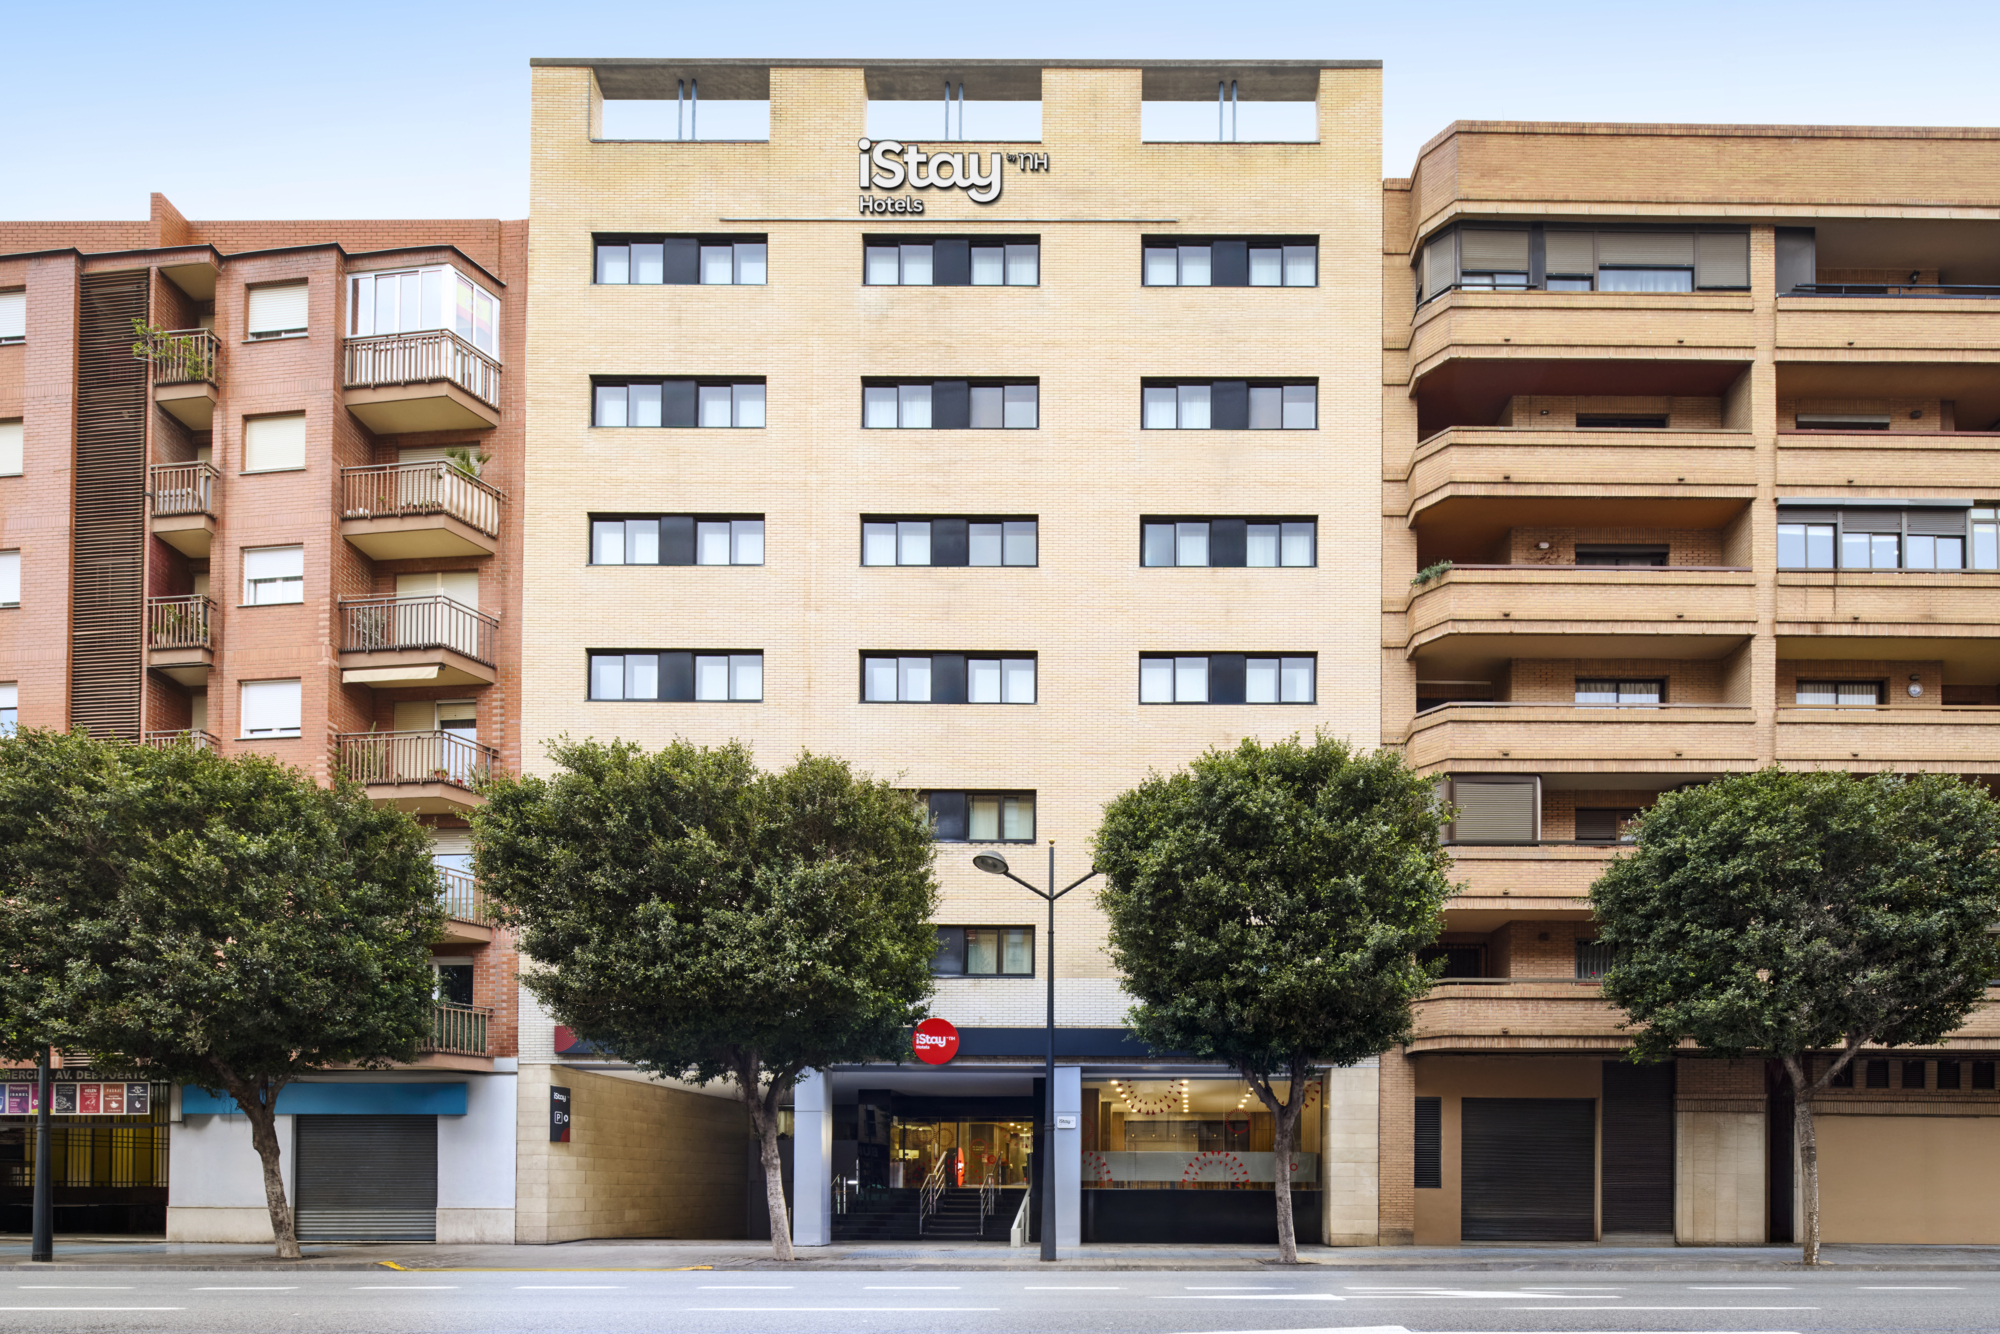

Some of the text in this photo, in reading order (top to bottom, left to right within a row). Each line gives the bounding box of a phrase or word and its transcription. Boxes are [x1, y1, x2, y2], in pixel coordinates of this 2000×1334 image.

[858, 137, 1002, 203] iStay
[1006, 153, 1016, 162] by
[858, 195, 924, 213] Hotels
[916, 1033, 946, 1047] iStay
[55, 1070, 73, 1080] AV.
[557, 1114, 560, 1122] P
